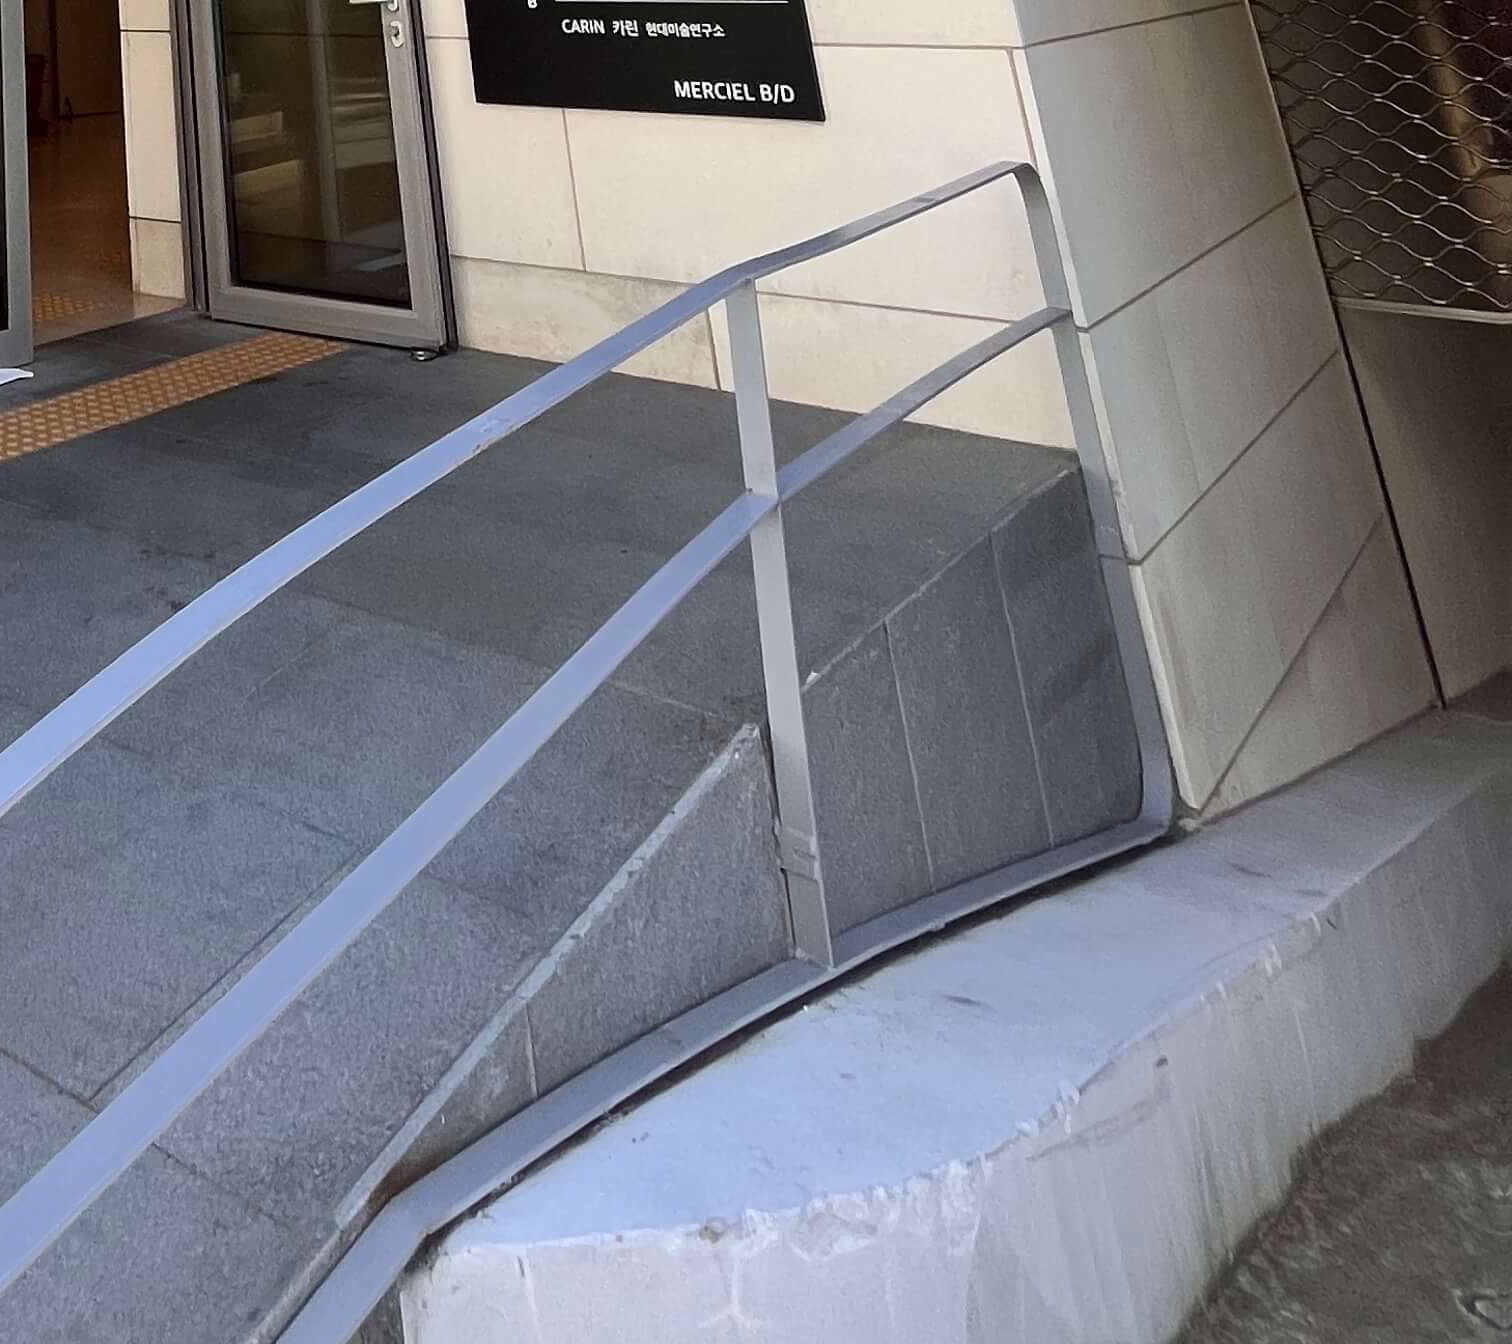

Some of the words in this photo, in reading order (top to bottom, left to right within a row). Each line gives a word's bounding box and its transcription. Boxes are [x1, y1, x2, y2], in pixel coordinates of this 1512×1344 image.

[561, 18, 606, 34] CARIN
[612, 19, 639, 37] 카린
[645, 21, 726, 38] 현대미술연구소
[673, 79, 756, 102] MERCIEL
[759, 83, 796, 105] B/D
